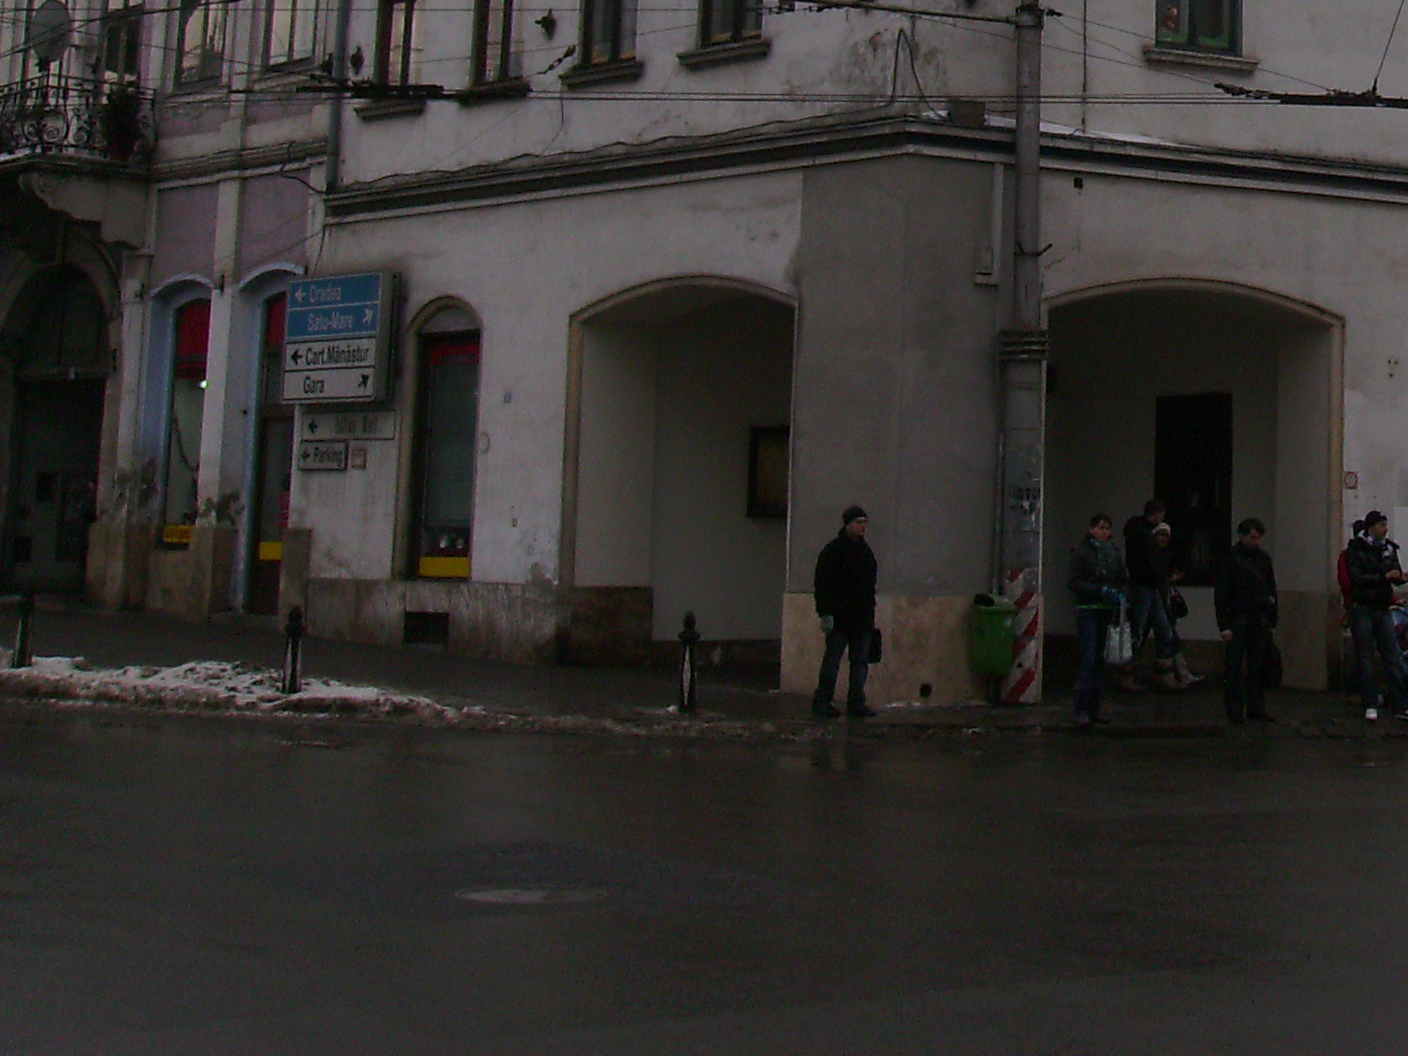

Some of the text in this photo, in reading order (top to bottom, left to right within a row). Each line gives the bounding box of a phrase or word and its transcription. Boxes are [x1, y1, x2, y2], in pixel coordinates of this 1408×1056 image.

[309, 284, 342, 303] Oradea
[307, 311, 354, 332] Satu-Mare
[303, 375, 325, 394] Gara
